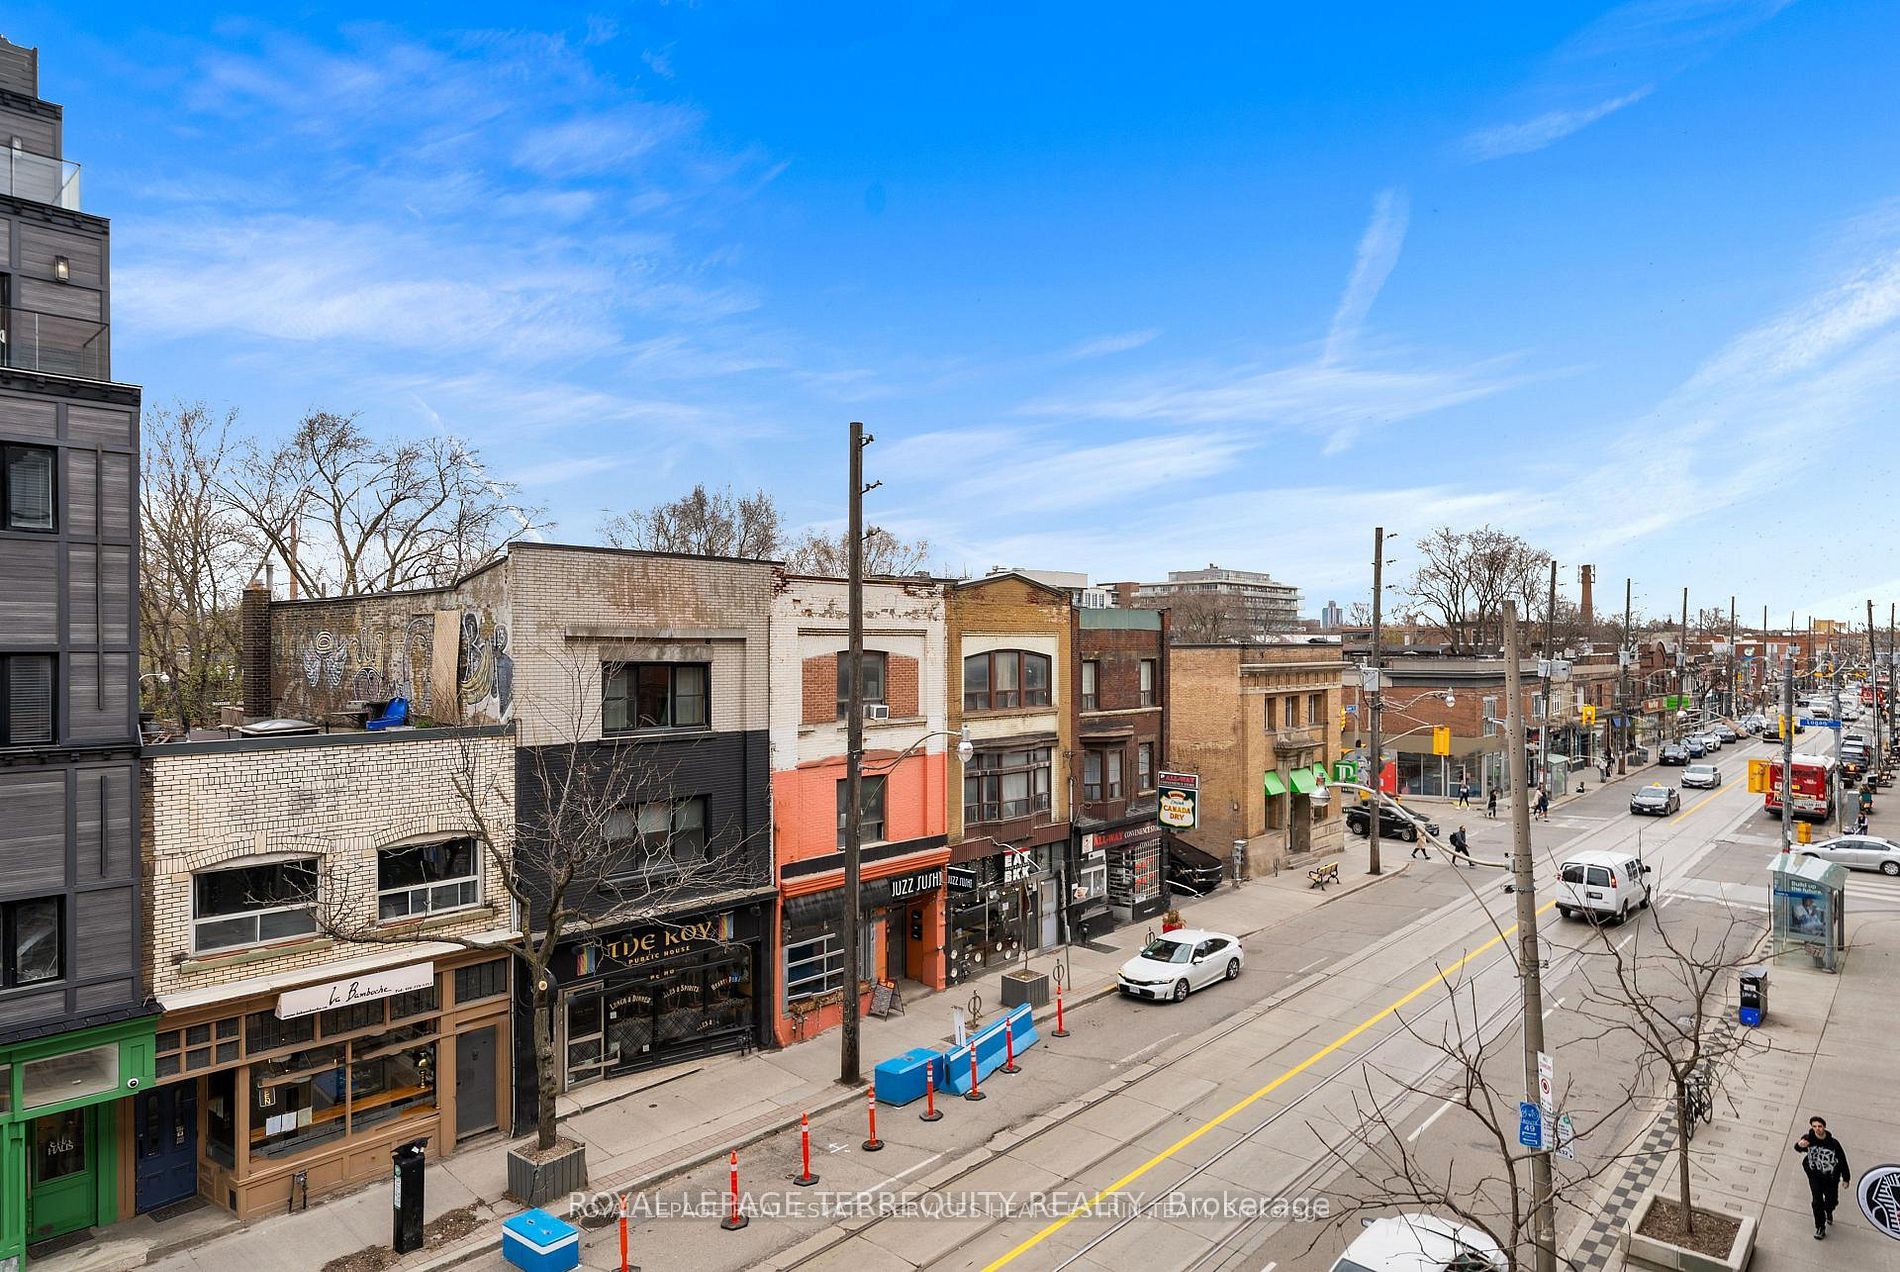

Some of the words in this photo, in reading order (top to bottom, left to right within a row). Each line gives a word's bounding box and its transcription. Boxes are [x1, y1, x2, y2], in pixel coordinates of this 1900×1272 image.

[1335, 764, 1354, 780] TD
[1163, 805, 1191, 814] CANADA
[1004, 850, 1031, 868] EAT
[1004, 866, 1030, 883] BKK
[892, 878, 914, 897] JUZZ
[916, 871, 942, 892] SUSHI
[1791, 880, 1808, 888] Build
[606, 934, 656, 958] THE
[664, 921, 713, 946] ROY
[628, 952, 660, 965] PUBLIC
[664, 945, 690, 957] HOUSE
[329, 986, 341, 1006] La
[345, 981, 392, 1003] Bamboche
